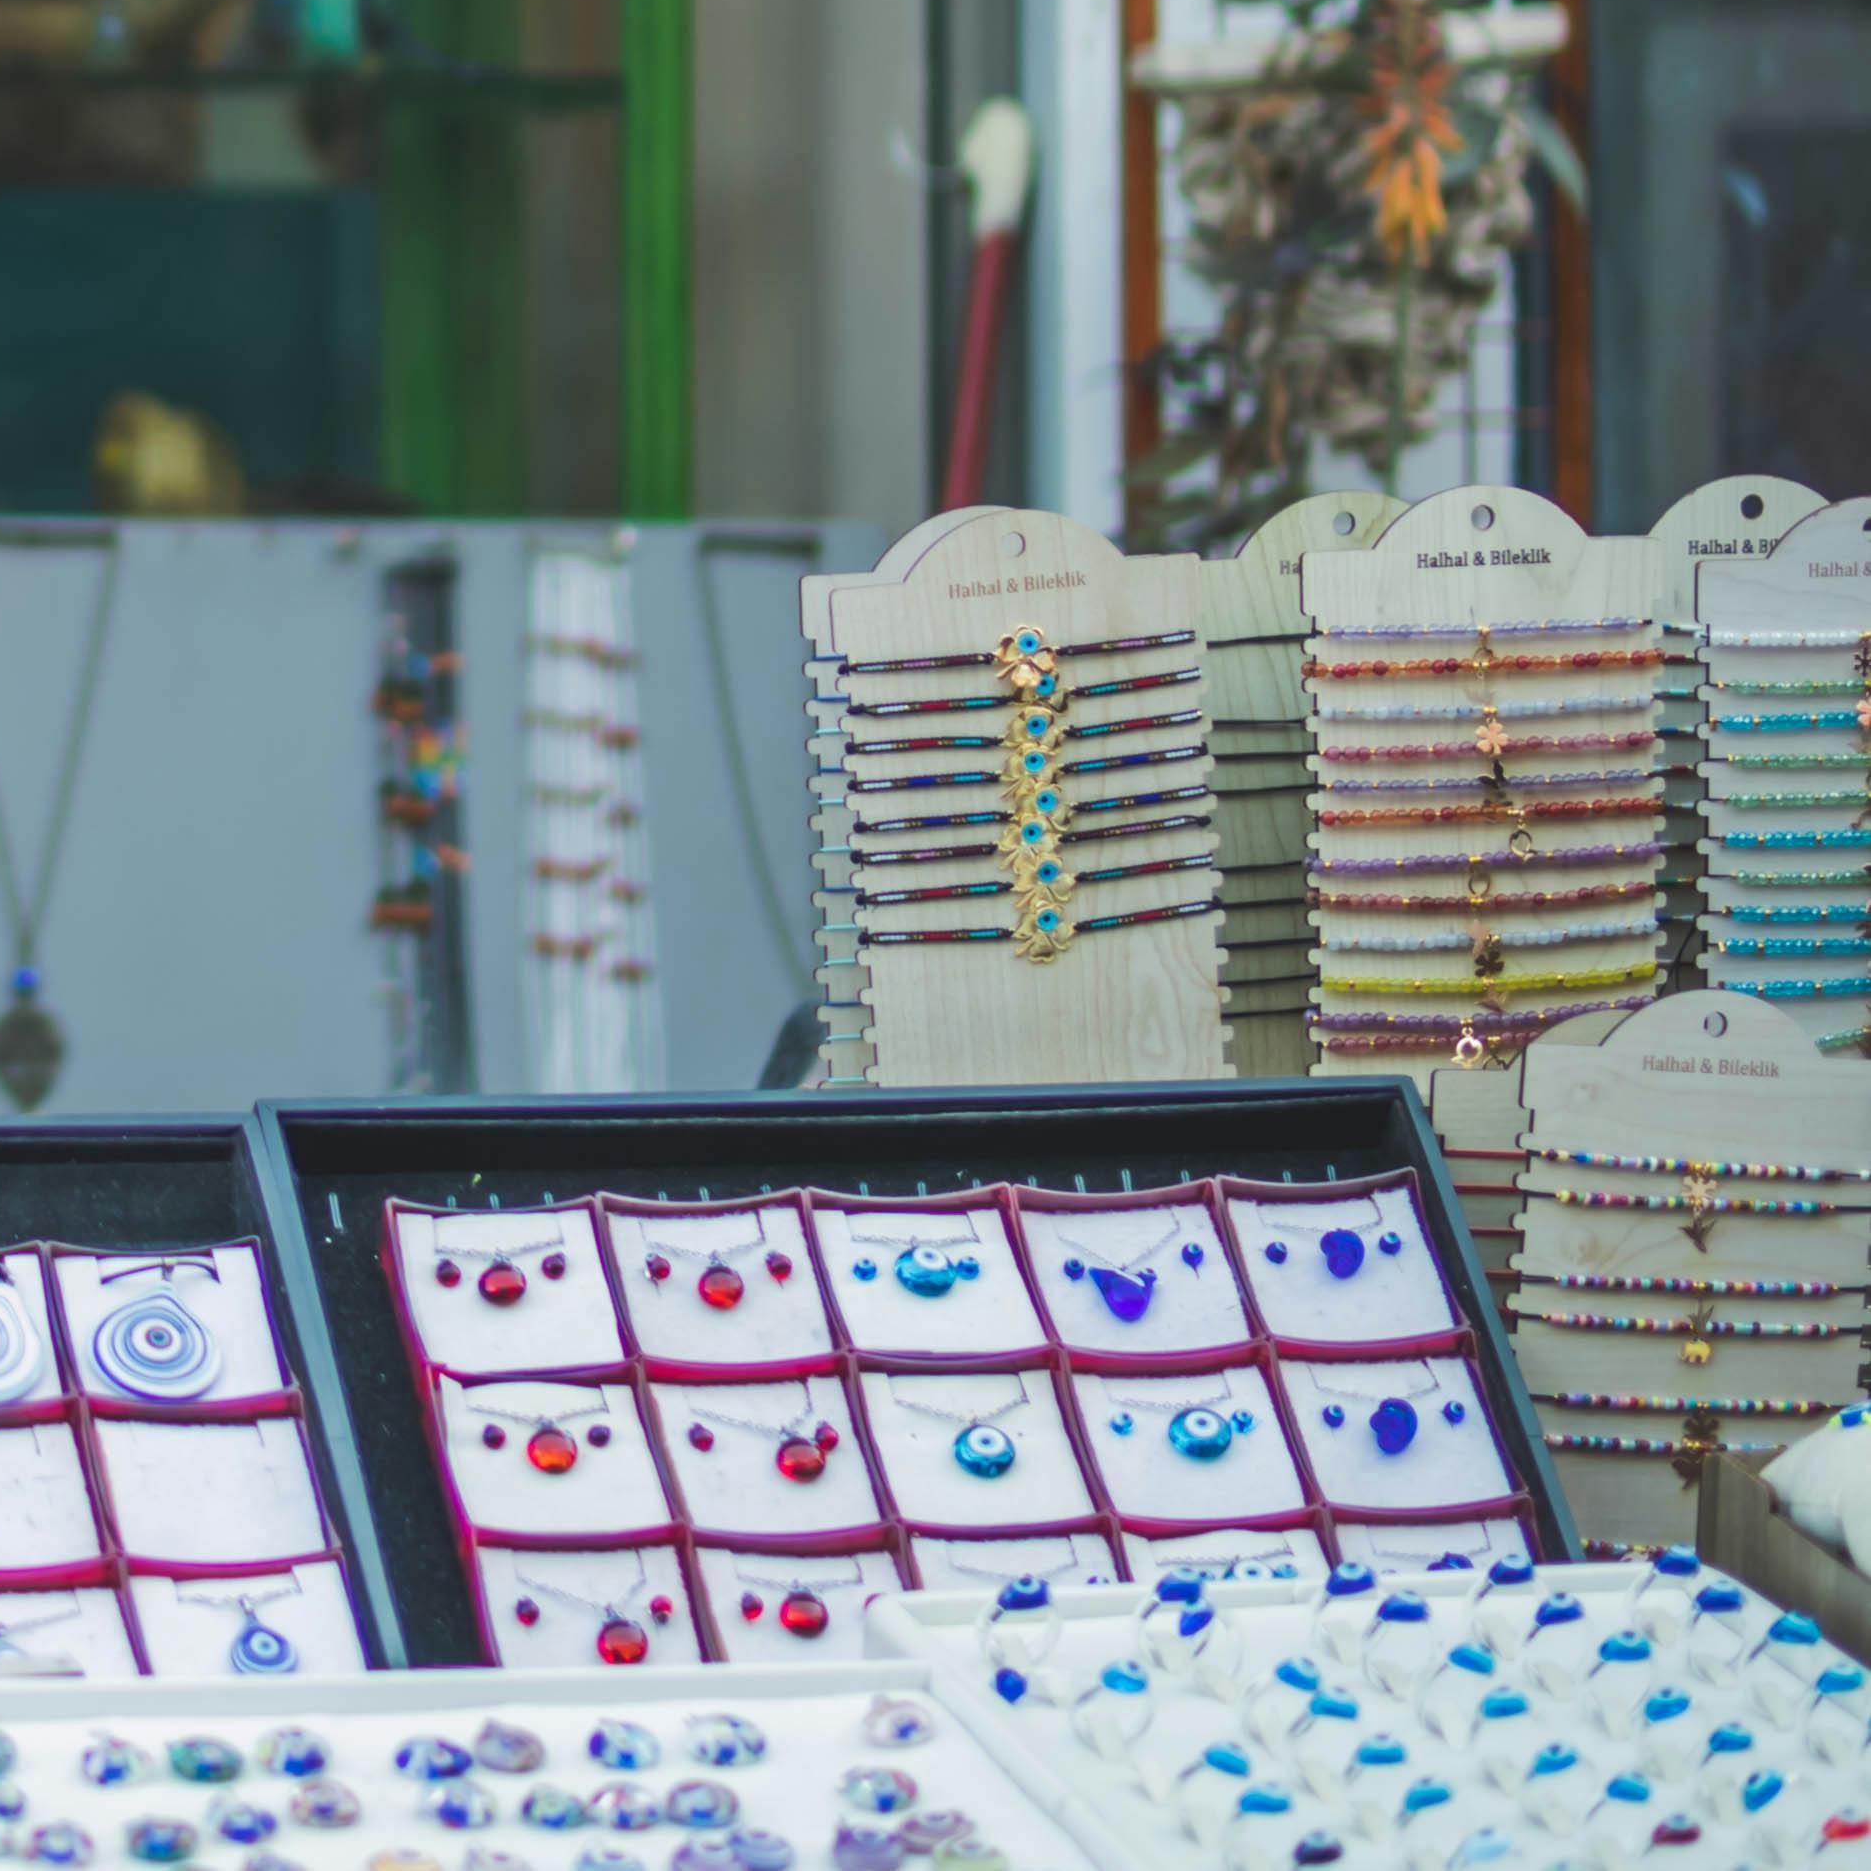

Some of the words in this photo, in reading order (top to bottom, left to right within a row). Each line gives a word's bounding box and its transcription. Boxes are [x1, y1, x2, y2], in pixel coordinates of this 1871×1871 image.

[1687, 539, 1737, 555] Halhal
[1742, 539, 1754, 554] &
[1417, 551, 1469, 569] Halhal
[1473, 551, 1485, 566] &
[1490, 548, 1552, 566] Bileklik
[1809, 562, 1858, 578] Halhal
[948, 578, 1001, 599] Halhal
[1006, 578, 1018, 593] &
[1024, 571, 1087, 592] Bileklik
[1642, 1055, 1695, 1073] Halhal
[1700, 1058, 1713, 1074] &
[1718, 1059, 1779, 1077] Bileklik
